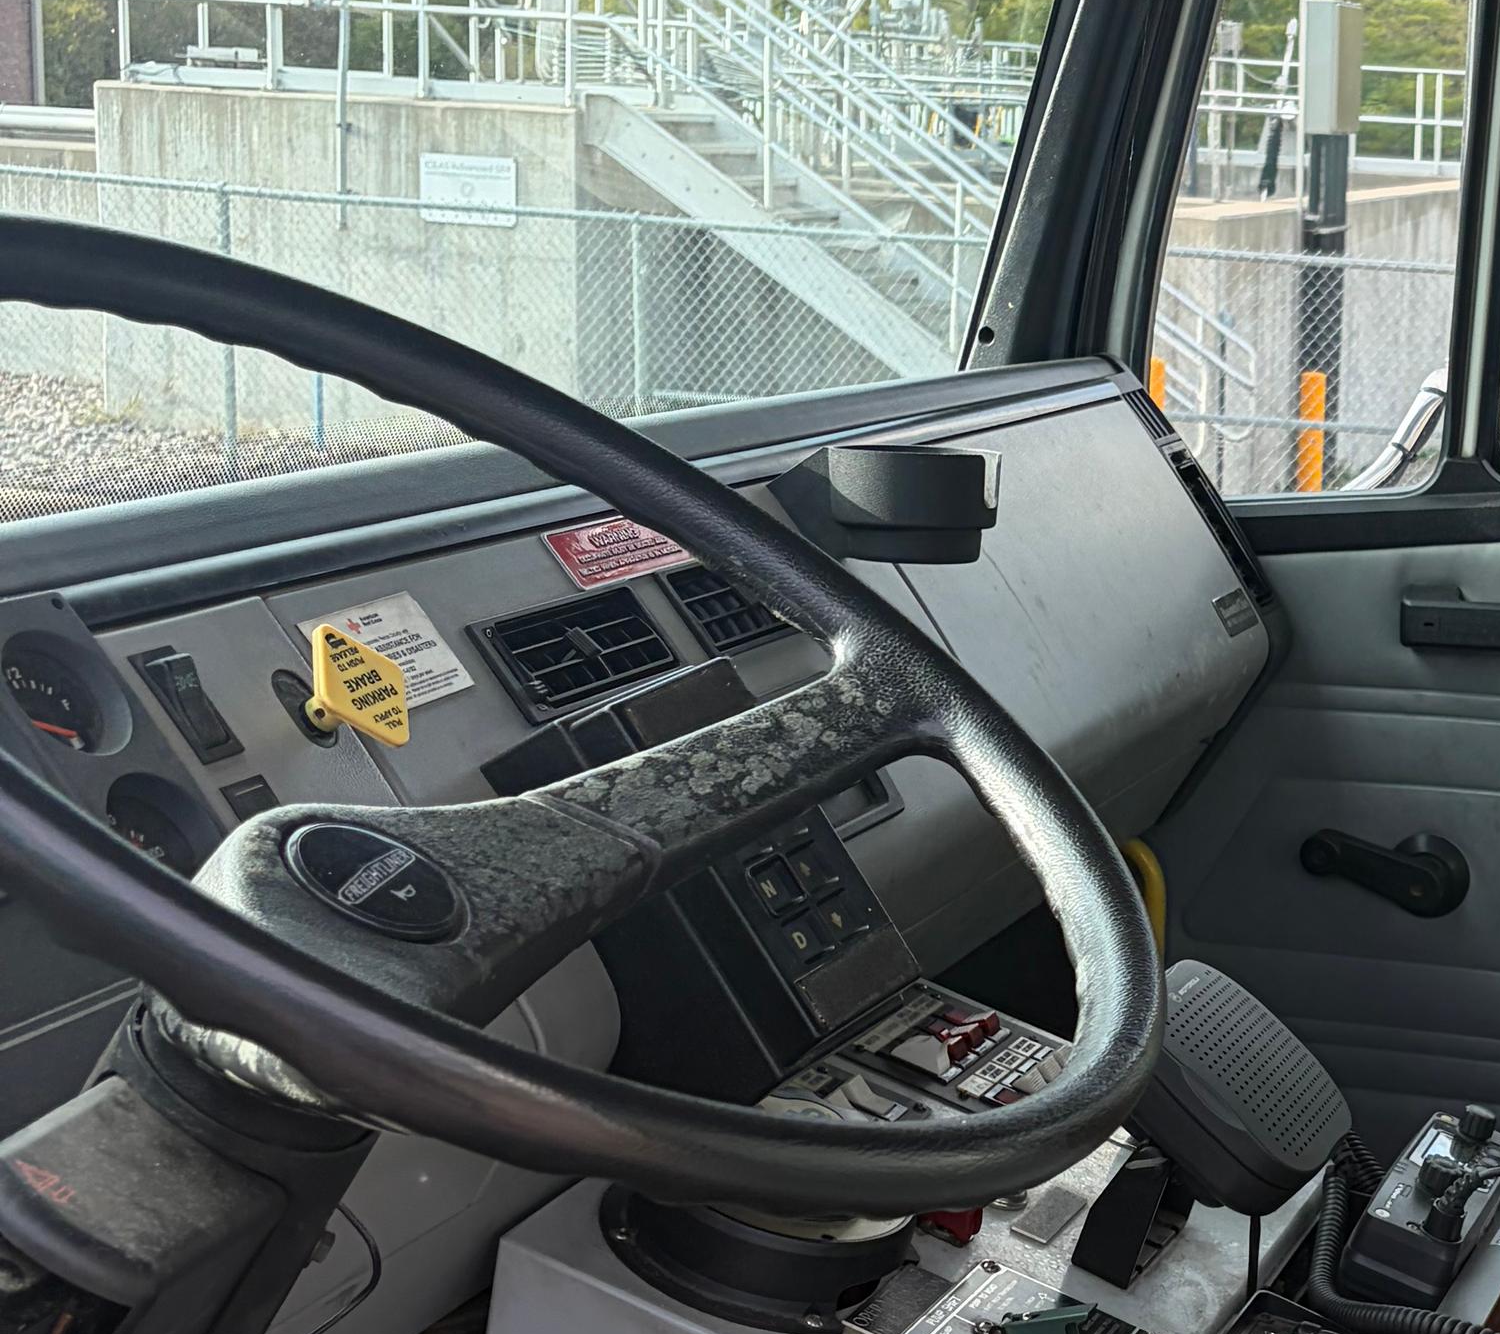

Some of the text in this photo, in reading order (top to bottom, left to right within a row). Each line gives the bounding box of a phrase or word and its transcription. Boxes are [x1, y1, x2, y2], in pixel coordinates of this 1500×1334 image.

[589, 527, 641, 548] WARNING
[329, 646, 359, 662] RELEASE
[336, 656, 365, 672] PUSH TO
[343, 669, 382, 693] BRAKE
[351, 683, 399, 711] PARKING
[373, 706, 402, 724] TO APPLY
[385, 718, 404, 730] PULL
[344, 850, 411, 901] FREIGHTLINER
[760, 879, 778, 899] N
[791, 931, 808, 949] D
